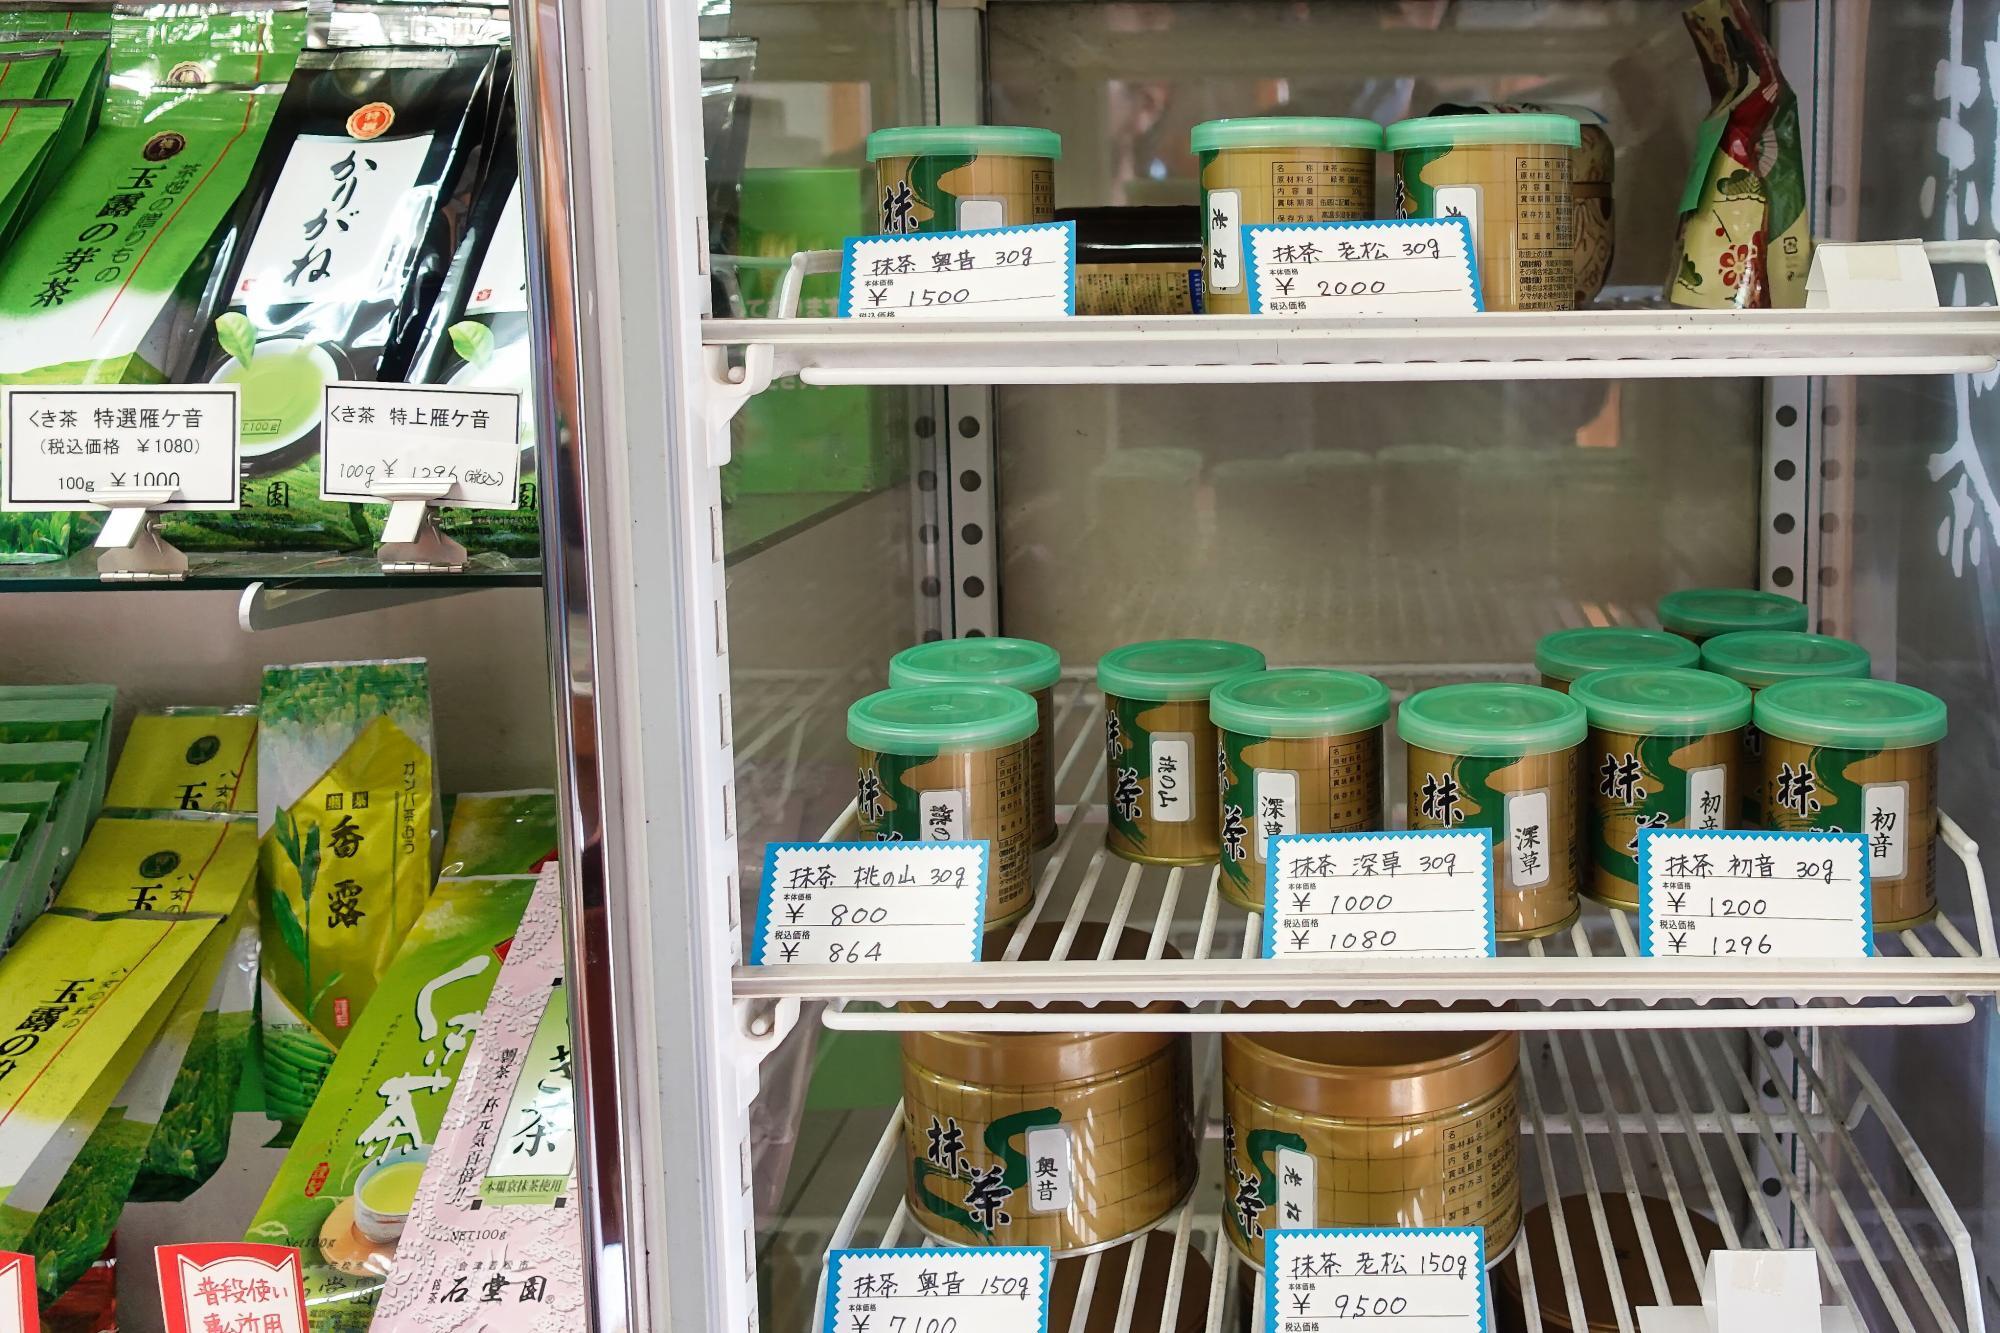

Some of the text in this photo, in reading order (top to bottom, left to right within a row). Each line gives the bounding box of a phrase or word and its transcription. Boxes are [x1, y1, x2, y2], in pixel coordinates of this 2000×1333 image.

[284, 150, 377, 286] かりがね
[30, 166, 167, 307] 玉露の芽茶
[872, 255, 916, 276] 抹茶
[995, 247, 1033, 266] 30g
[1273, 239, 1439, 263] 抹茶 老松 30g
[865, 279, 894, 287] 本体価格
[1317, 281, 1385, 296] 2000
[909, 288, 970, 307] 1500
[1270, 302, 1306, 311] 税込価格
[29, 408, 203, 428] くき茶 特選雁ケ音
[331, 406, 490, 429] くき茶 特上雁ケ音
[41, 439, 120, 454] (税込価格
[58, 477, 95, 492] 100g
[340, 464, 376, 488] 100g
[1870, 807, 1896, 858] 初音
[1514, 824, 1541, 876] 深草
[327, 815, 365, 929] 香露
[1290, 851, 1456, 878] 抹茶 深草 30g
[1665, 853, 1833, 884] 抹茶 初音 30g
[790, 864, 965, 889] 抹茶 桃の山 30g
[1662, 882, 1691, 890] 本体価格
[784, 893, 812, 901] 本体価格
[1331, 895, 1392, 914] 1000
[1710, 897, 1766, 917] 1200
[831, 904, 887, 926] 800
[1284, 919, 1319, 928] 税込価格
[1660, 920, 1696, 930] 税込価格
[775, 931, 810, 939] 税込価格
[1330, 930, 1396, 949] 1080
[1714, 934, 1772, 955] 1296
[829, 941, 881, 963] 864
[1291, 1252, 1467, 1280] 抹茶 老松 150g
[194, 1277, 288, 1306] 普段使い
[441, 1273, 547, 1303] 石堂園
[854, 1273, 898, 1298] 抹茶
[981, 1276, 1028, 1300] 150g
[890, 1316, 957, 1333] 7100
[1285, 1323, 1319, 1333] 税込価格
